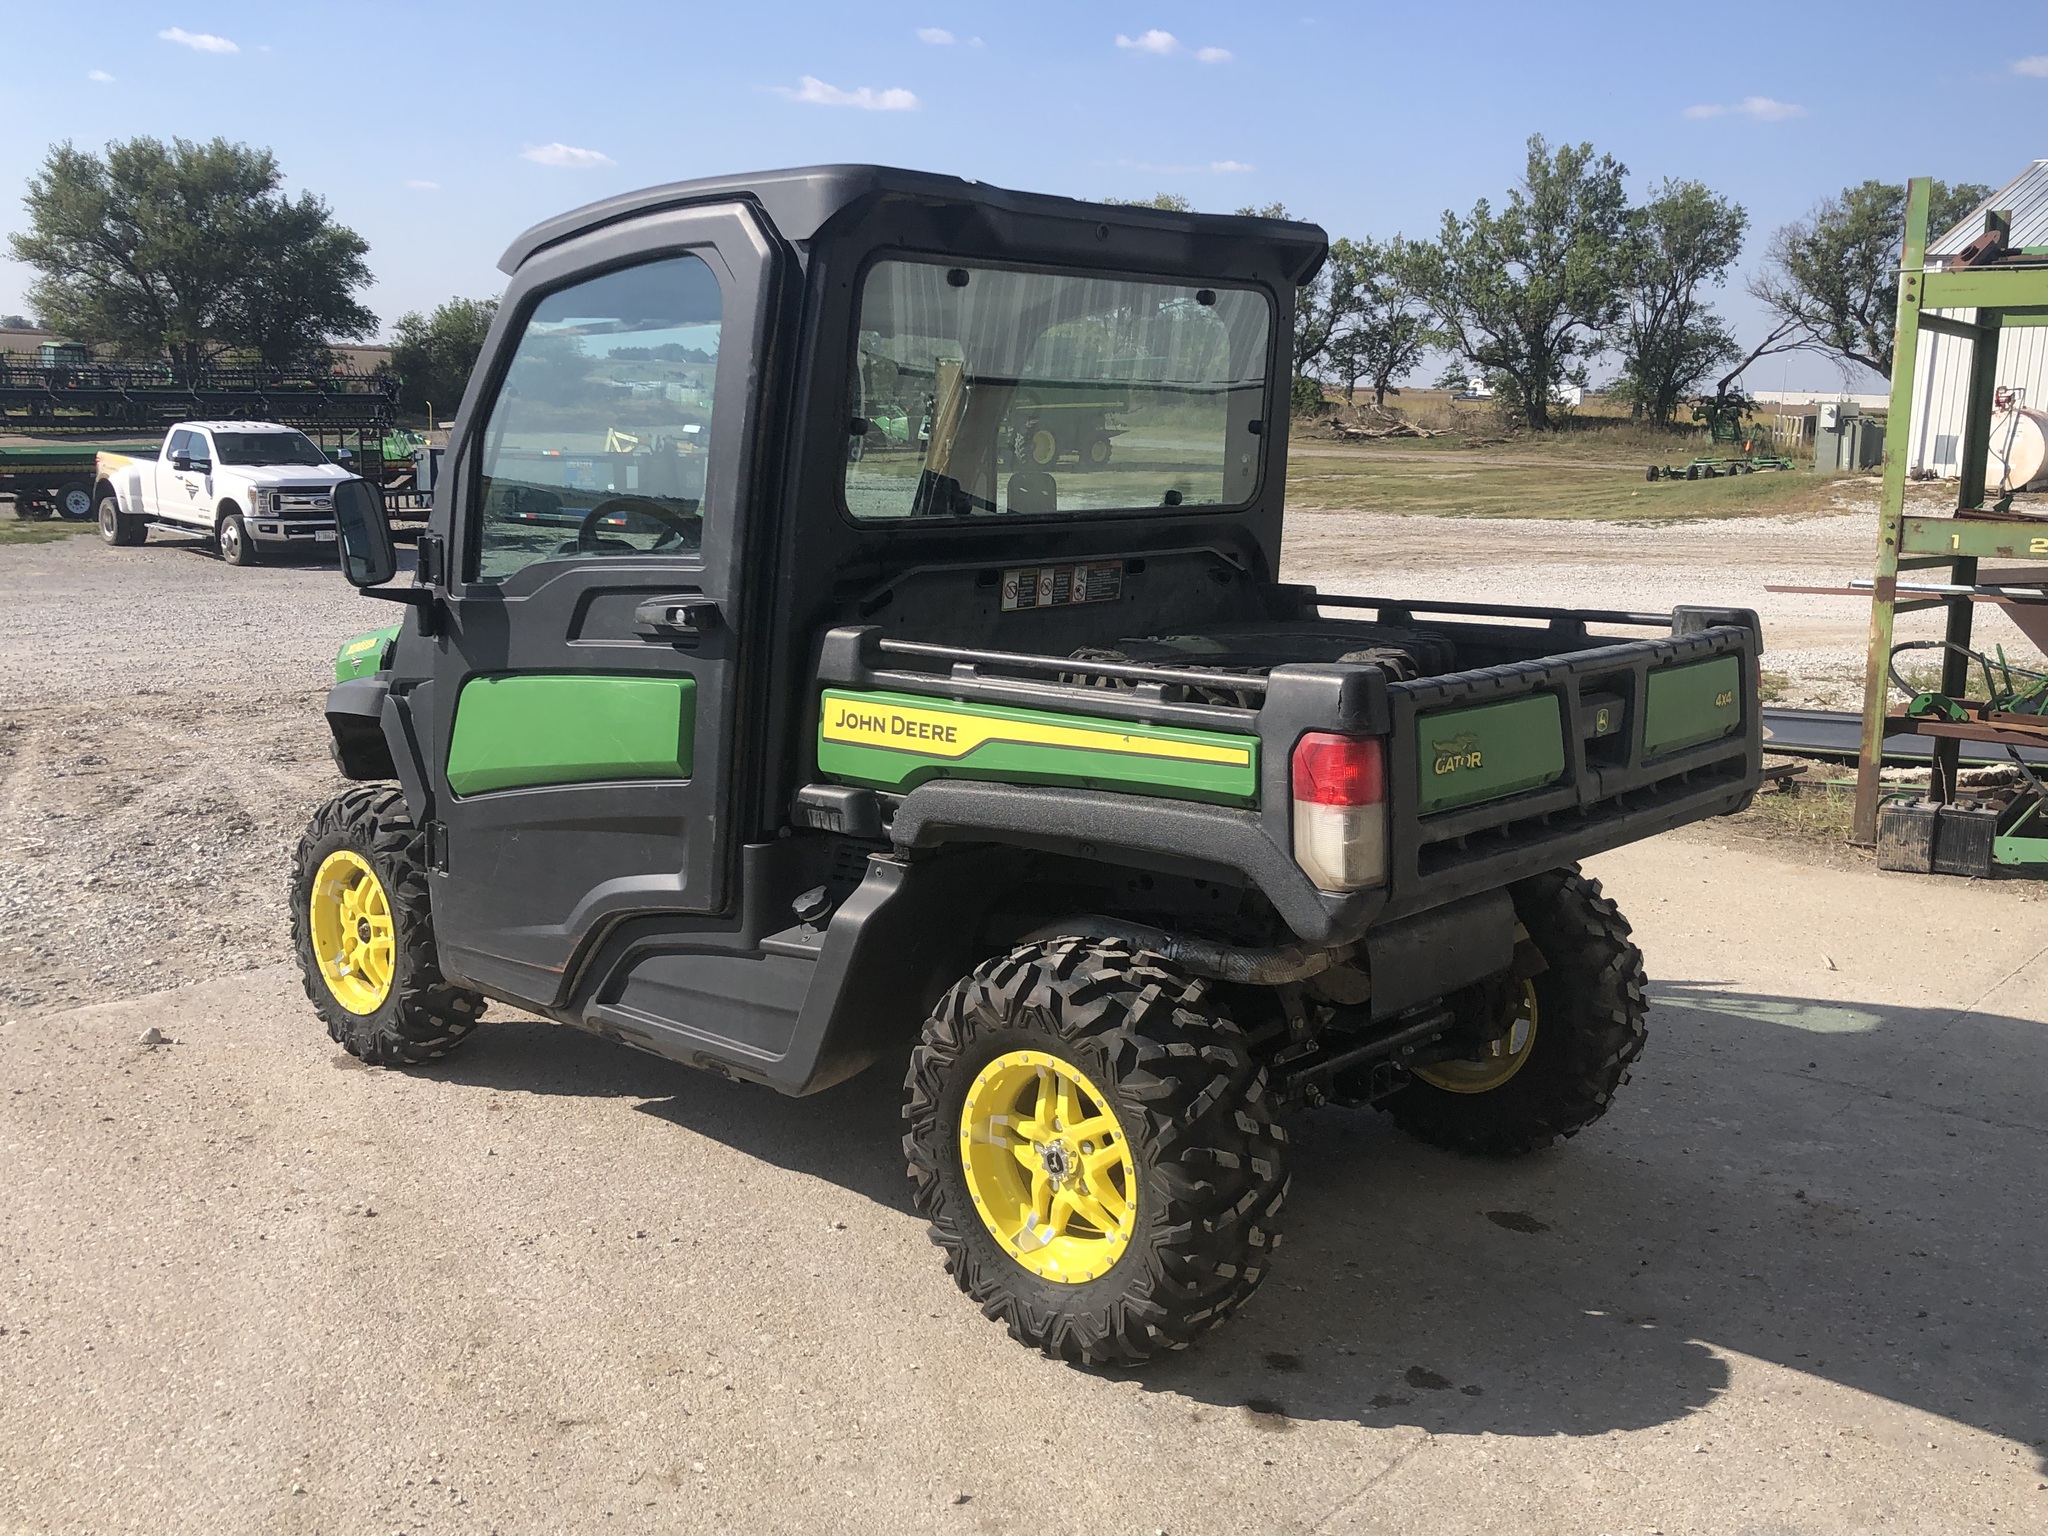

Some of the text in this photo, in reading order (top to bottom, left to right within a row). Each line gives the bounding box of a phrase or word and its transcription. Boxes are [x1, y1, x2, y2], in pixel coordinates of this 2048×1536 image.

[1951, 534, 1960, 549] 1
[2029, 537, 2048, 553] 2
[835, 708, 958, 743] JOHN DEERE
[1435, 751, 1482, 775] GATOR
